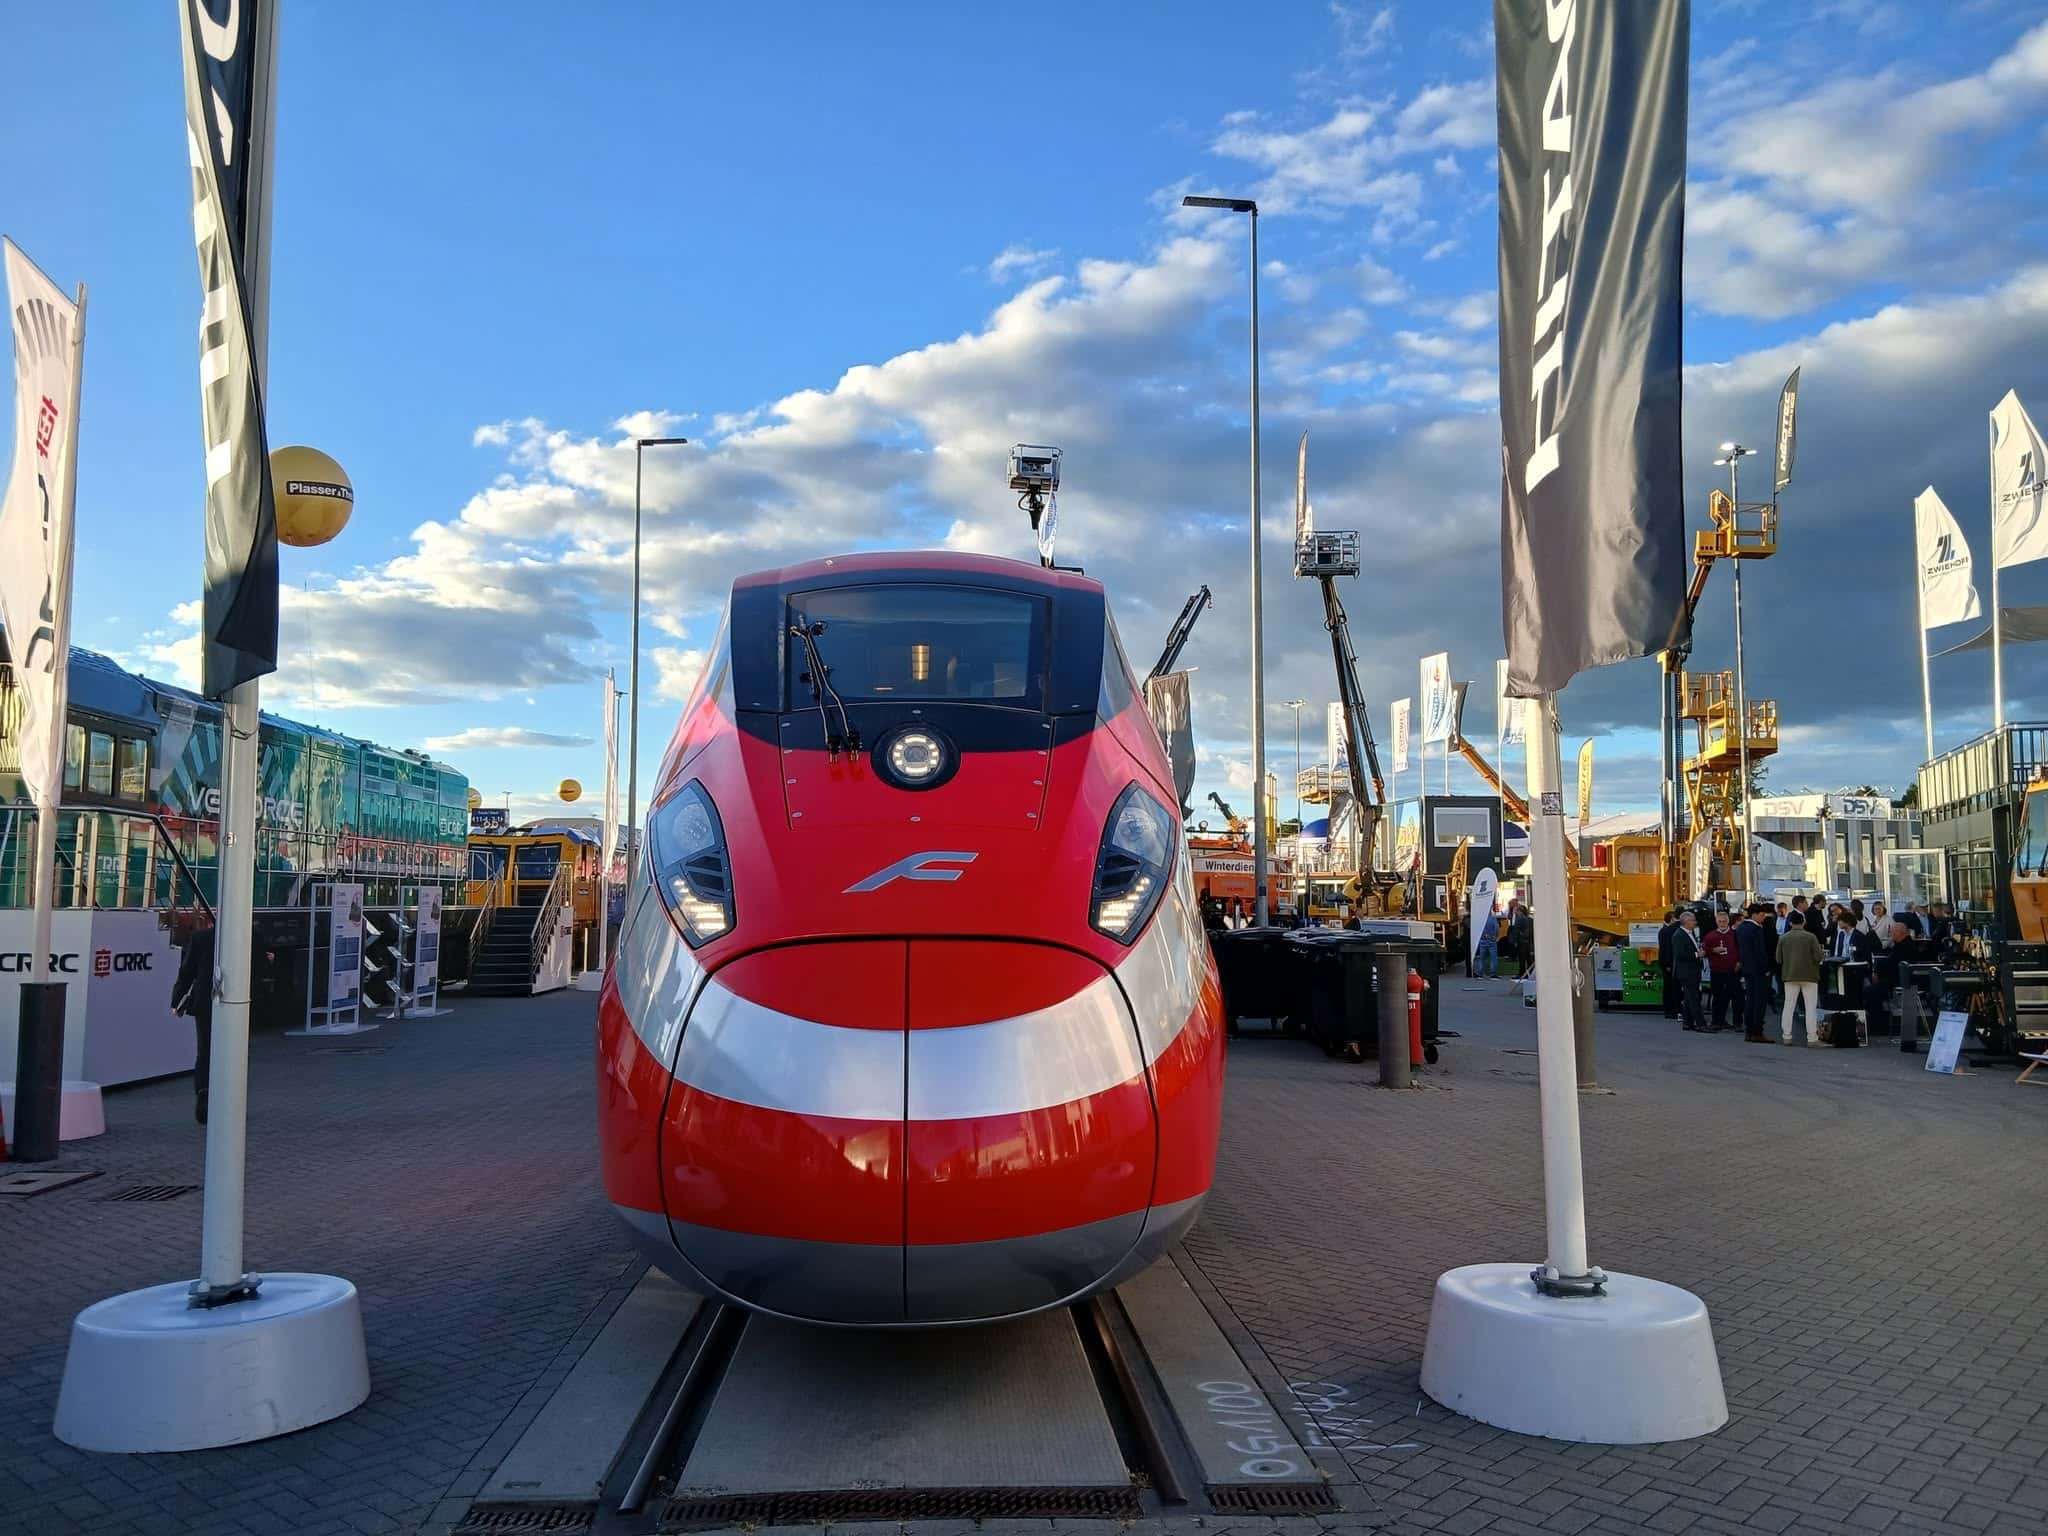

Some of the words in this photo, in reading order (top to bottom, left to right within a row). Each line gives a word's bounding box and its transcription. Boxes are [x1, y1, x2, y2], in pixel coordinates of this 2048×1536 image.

[289, 482, 337, 496] Plasser
[1763, 799, 1805, 816] DSV
[114, 953, 152, 971] CRRC
